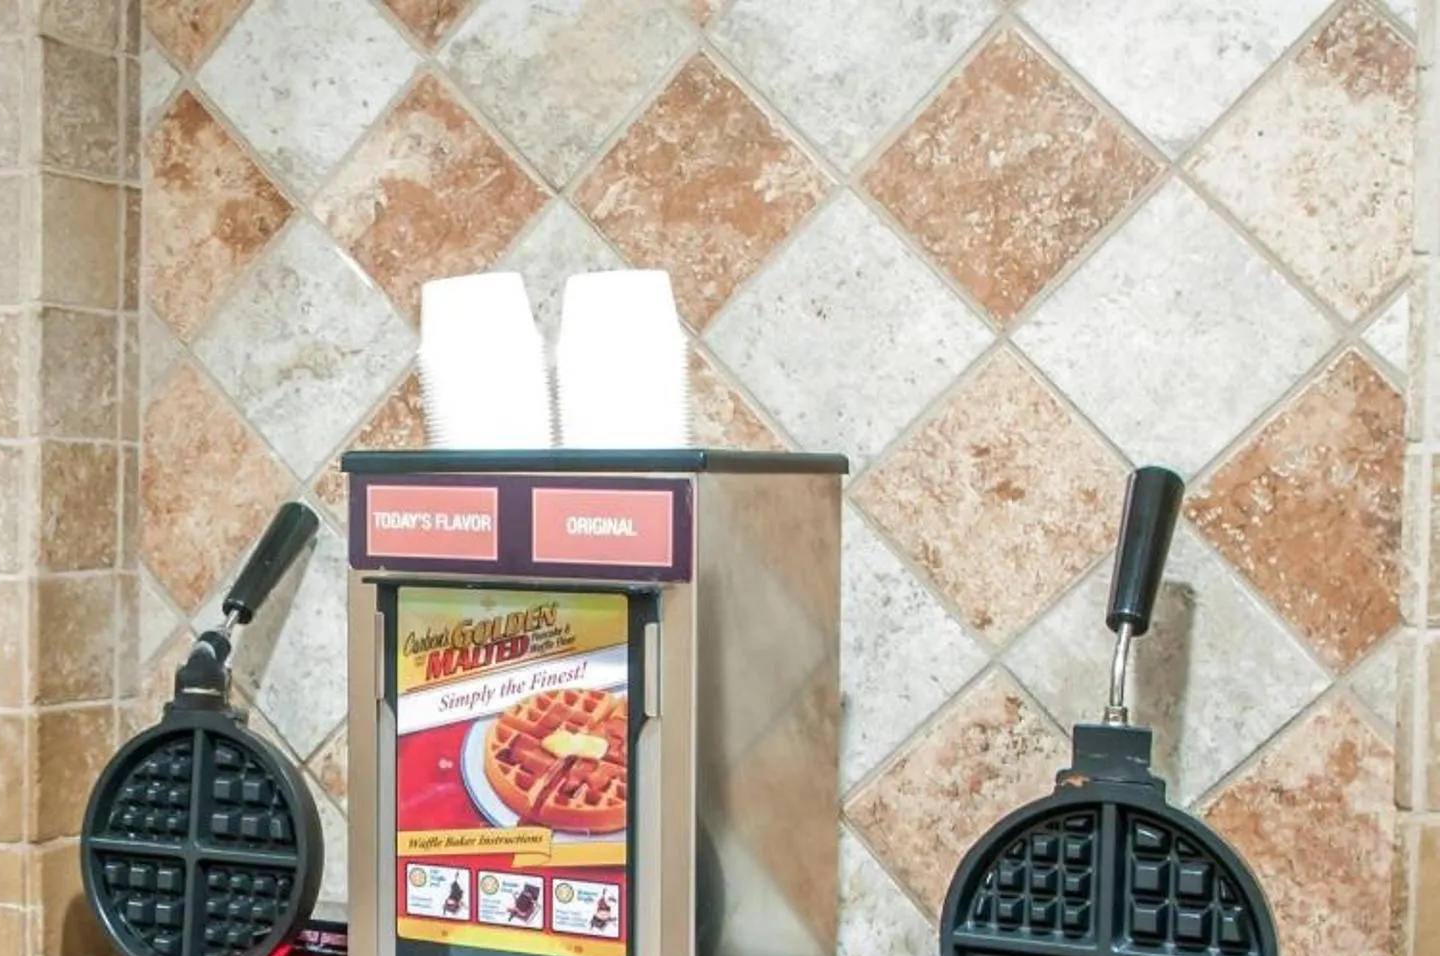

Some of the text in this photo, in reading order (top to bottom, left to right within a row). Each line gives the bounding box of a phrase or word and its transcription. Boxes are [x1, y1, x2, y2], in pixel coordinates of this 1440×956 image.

[372, 511, 492, 533] TODAY'S FLAVOR
[566, 516, 638, 537] ORIGINAL
[451, 601, 559, 650] GOLDEN
[425, 634, 532, 681] MALTED
[438, 659, 589, 713] Simply the Finest!
[408, 834, 544, 850] Waffle Baker Instructions
